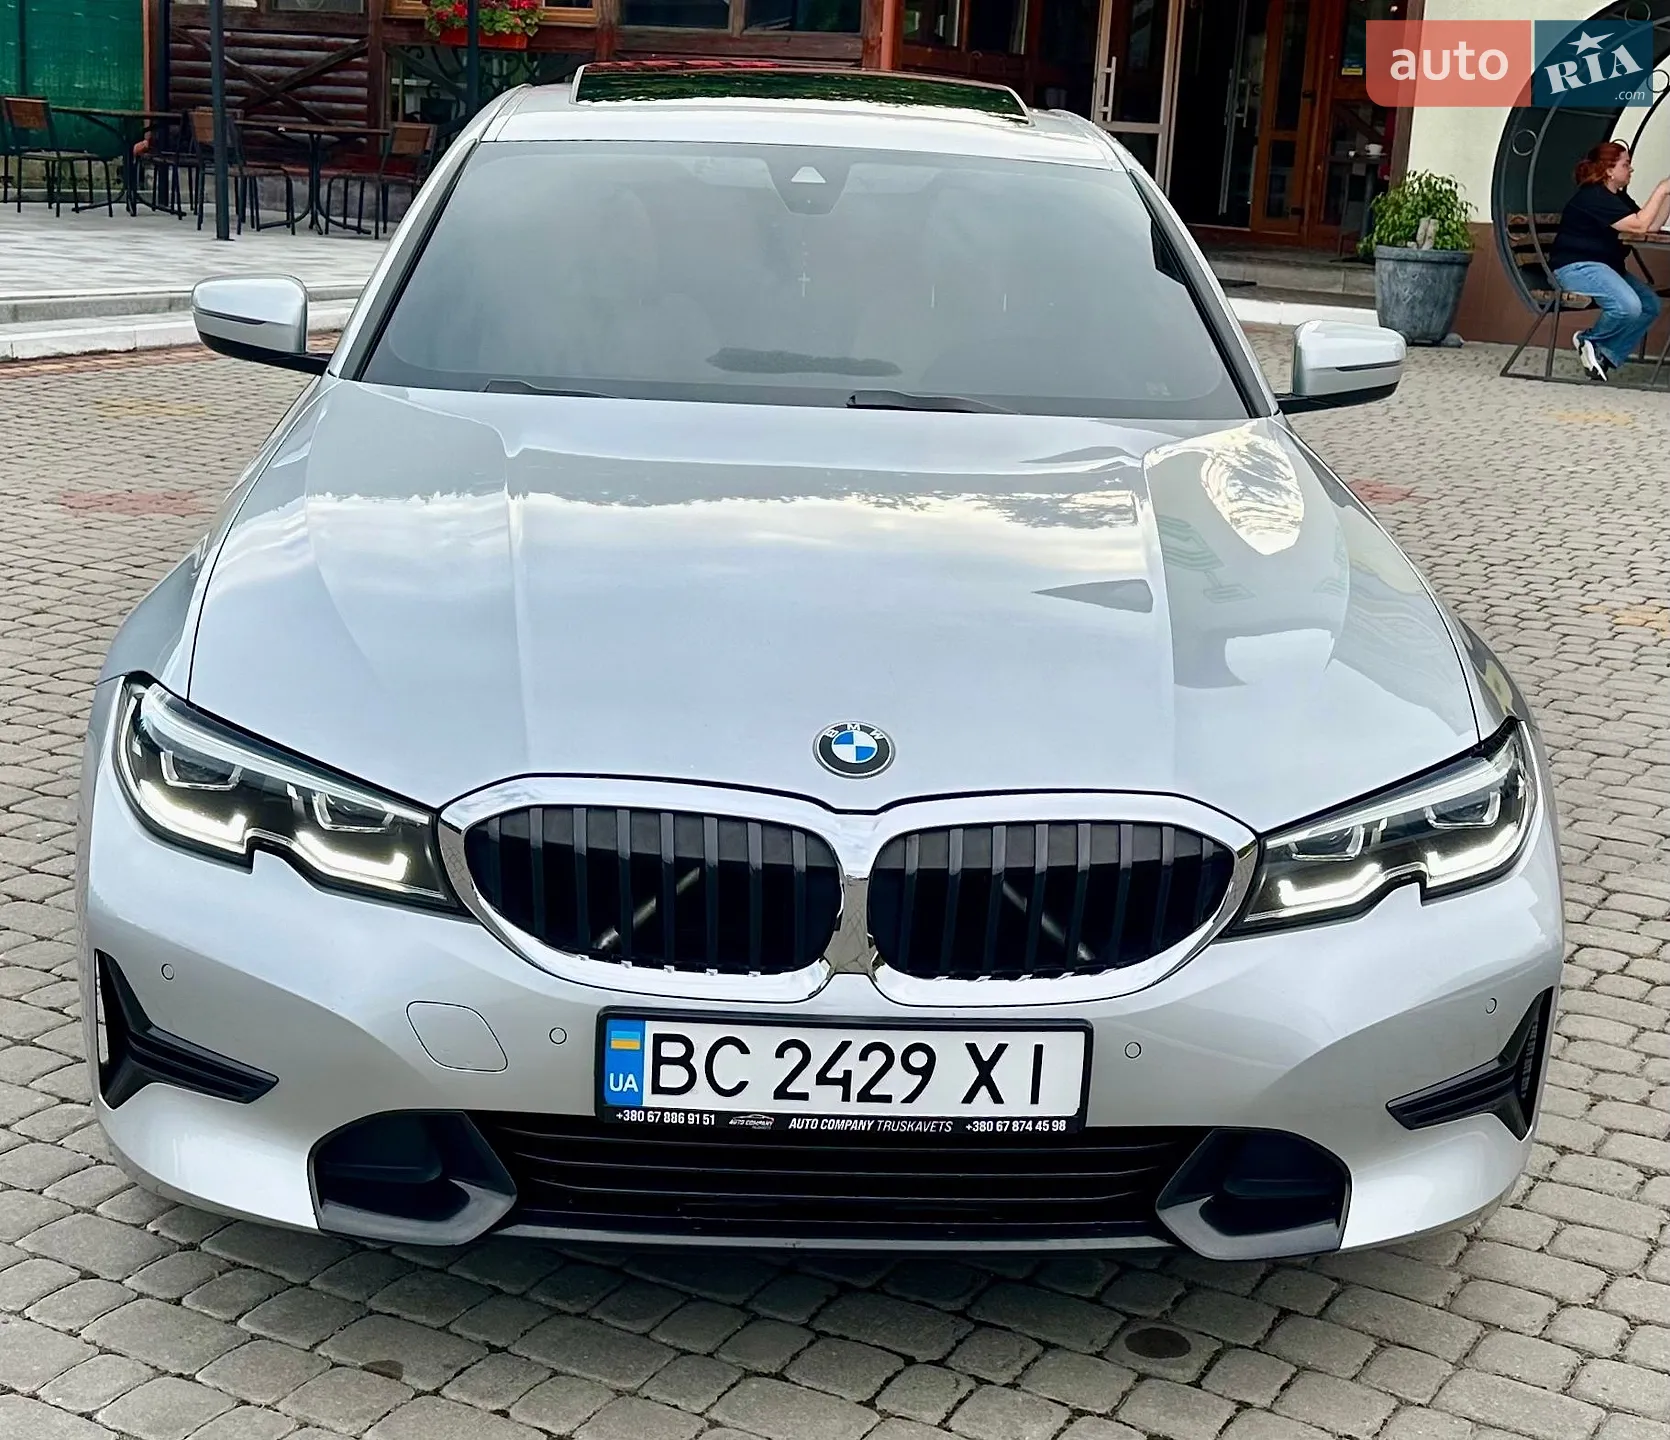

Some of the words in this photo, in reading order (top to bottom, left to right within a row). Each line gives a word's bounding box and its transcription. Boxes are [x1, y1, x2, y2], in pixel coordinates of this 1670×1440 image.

[824, 723, 885, 740] BMW
[651, 1032, 751, 1098] BC
[773, 1038, 937, 1104] 2429
[609, 1073, 639, 1093] UA
[616, 1109, 645, 1122] +380
[647, 1111, 661, 1123] 67
[663, 1111, 685, 1124] 886
[687, 1112, 700, 1125] 91
[702, 1113, 716, 1126] 51
[788, 1117, 819, 1130] AUTO
[820, 1118, 875, 1131] COMPANY
[876, 1119, 954, 1133] TRUSKAVETS
[965, 1120, 994, 1132] +380
[995, 1120, 1010, 1132] 67
[1011, 1120, 1033, 1132] 874
[1035, 1120, 1050, 1132] 45
[1051, 1119, 1067, 1132] 98
